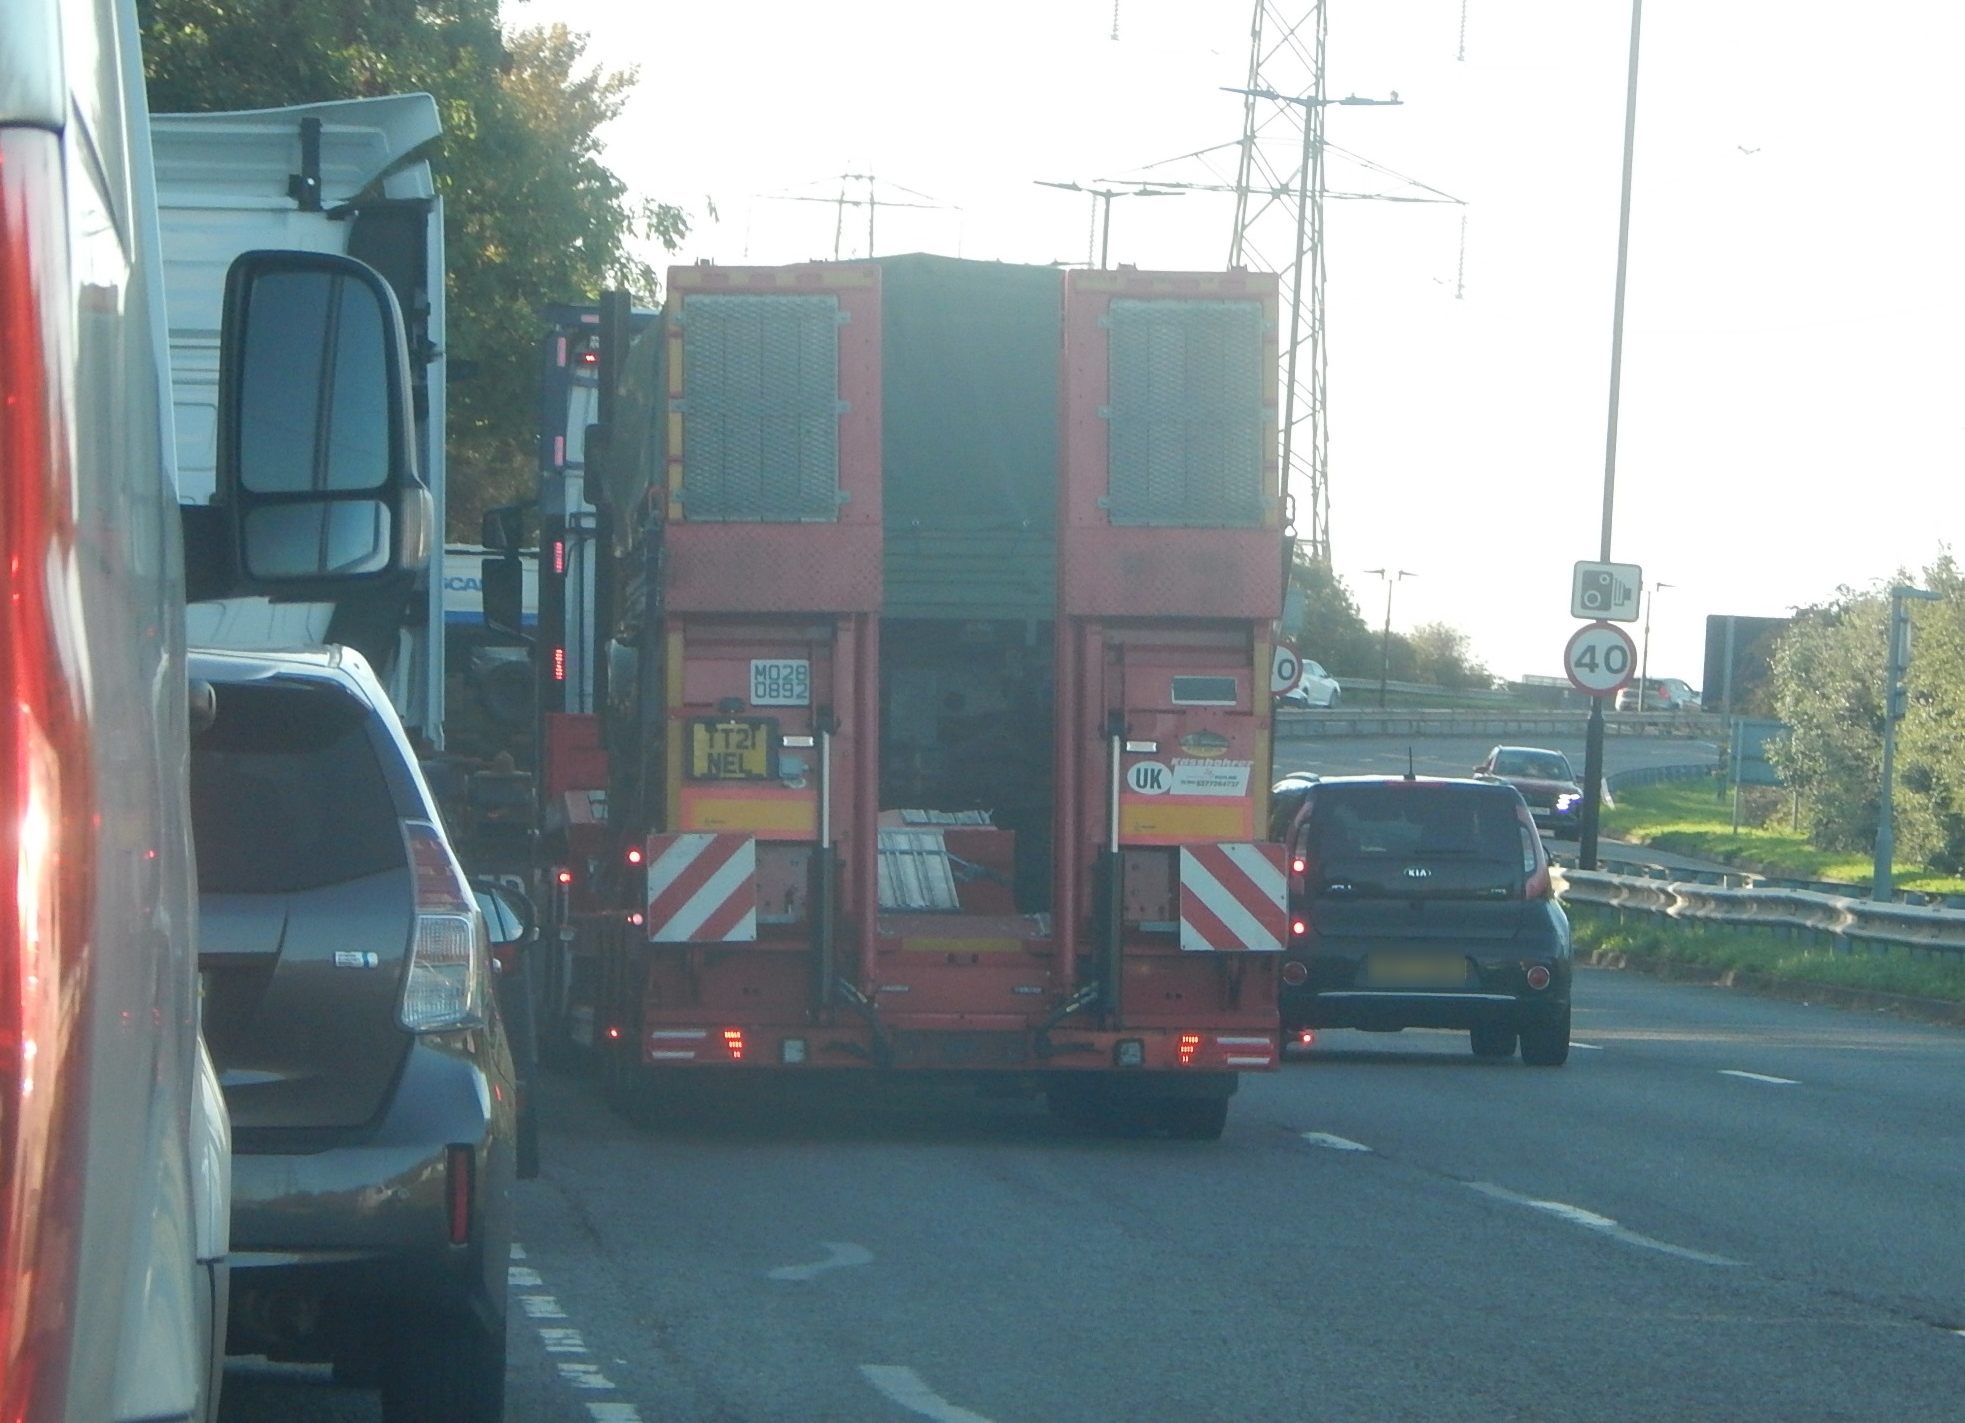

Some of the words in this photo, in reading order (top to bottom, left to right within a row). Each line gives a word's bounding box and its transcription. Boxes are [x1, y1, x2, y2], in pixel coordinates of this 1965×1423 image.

[444, 576, 482, 591] CA
[1574, 644, 1628, 675] 40
[707, 752, 752, 774] NEL
[1135, 768, 1162, 789] UK
[1408, 869, 1427, 877] KIA
